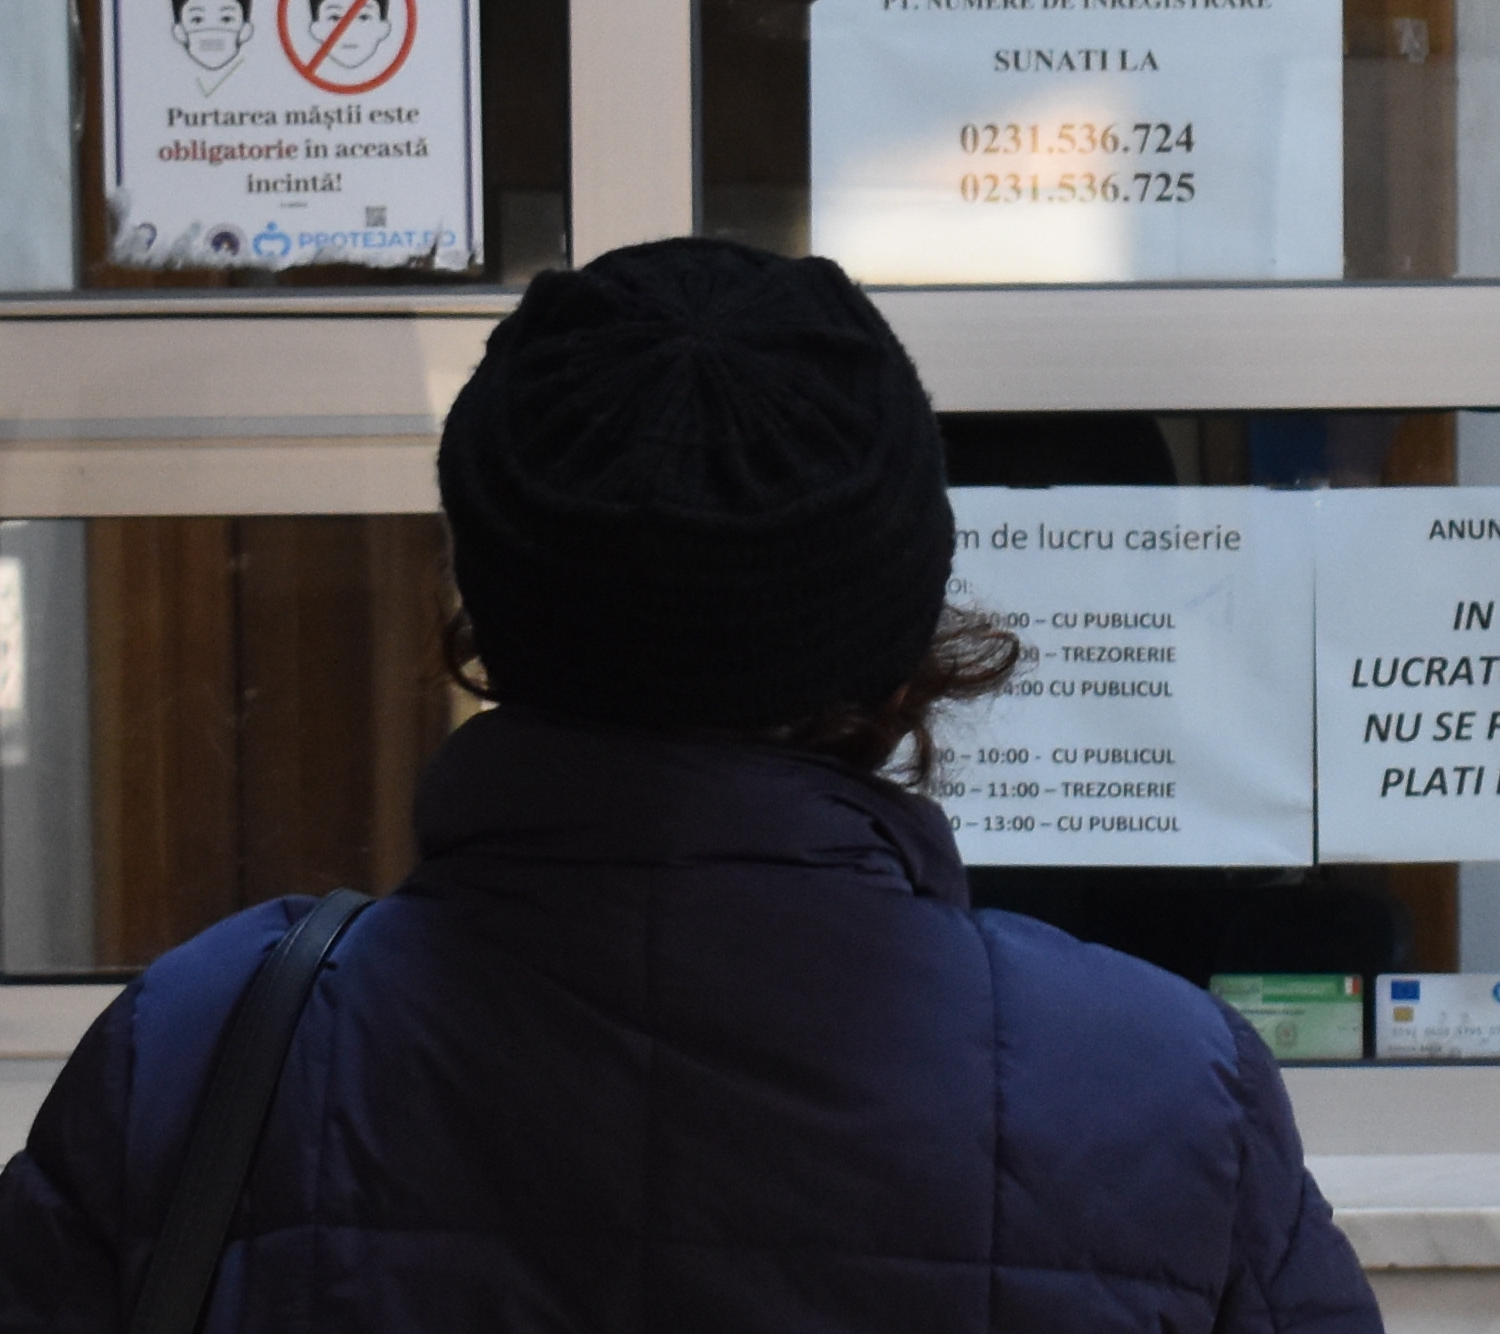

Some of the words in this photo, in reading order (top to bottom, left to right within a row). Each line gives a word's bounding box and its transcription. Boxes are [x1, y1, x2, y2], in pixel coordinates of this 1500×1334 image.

[995, 50, 1107, 71] SUNATI
[1120, 50, 1158, 70] LA
[168, 108, 277, 127] Purtarea
[369, 107, 419, 123] este
[959, 121, 1197, 156] 0231.536.724
[158, 139, 299, 165] obligatorie
[304, 140, 328, 158] în
[335, 139, 428, 158] această
[248, 173, 341, 193] incintă!
[959, 171, 1197, 205] 0231.536.725
[991, 523, 1028, 549] de
[1039, 523, 1113, 550] lucru
[1125, 525, 1241, 551] casierie
[1052, 613, 1077, 628] CU
[1084, 613, 1174, 629] PUBLICUL
[1454, 602, 1494, 630] IN
[1062, 647, 1174, 663] TREZORERIE
[1049, 680, 1075, 697] CU
[1081, 681, 1172, 697] PUBLICUL
[1364, 713, 1422, 742] NU
[1433, 712, 1475, 741] SE
[978, 748, 1029, 764] 10:00
[1052, 748, 1077, 764] CU
[1084, 748, 1174, 764] PUBLICUL
[989, 782, 1039, 798] 11:00
[1062, 782, 1175, 798] TREZORERIE
[1381, 767, 1484, 797] PLATI
[985, 816, 1035, 832] 13:00
[1057, 816, 1082, 832] CU
[1089, 816, 1179, 832] PUBLICUL
